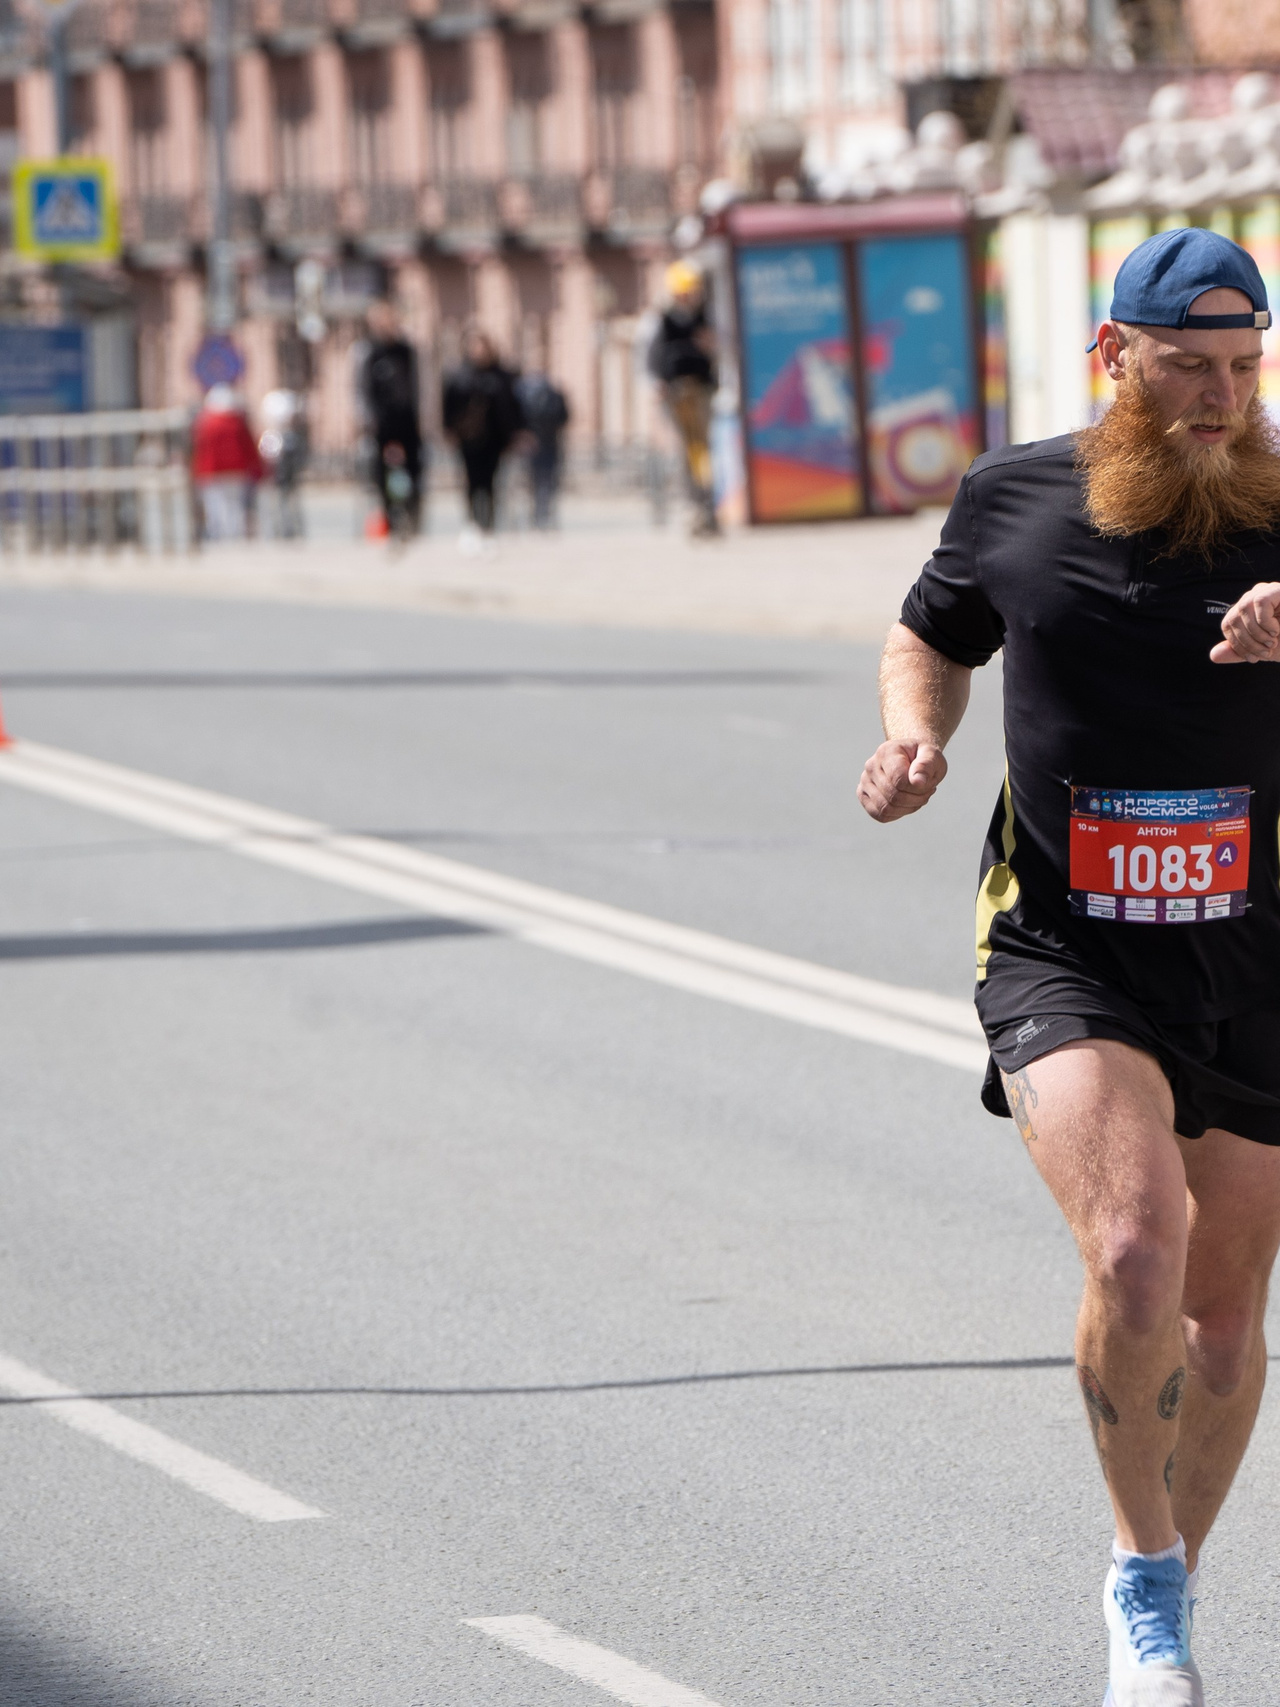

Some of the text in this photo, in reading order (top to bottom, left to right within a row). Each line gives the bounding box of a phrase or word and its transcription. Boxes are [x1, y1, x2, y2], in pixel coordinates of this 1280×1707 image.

[1124, 798, 1198, 807] Я ПРОСТО
[1124, 807, 1198, 817] КОСМОС
[1077, 823, 1087, 831] 10
[1137, 827, 1177, 836] АНТОН
[1108, 844, 1213, 893] 1083
[1013, 1023, 1049, 1057] NORDSKI
